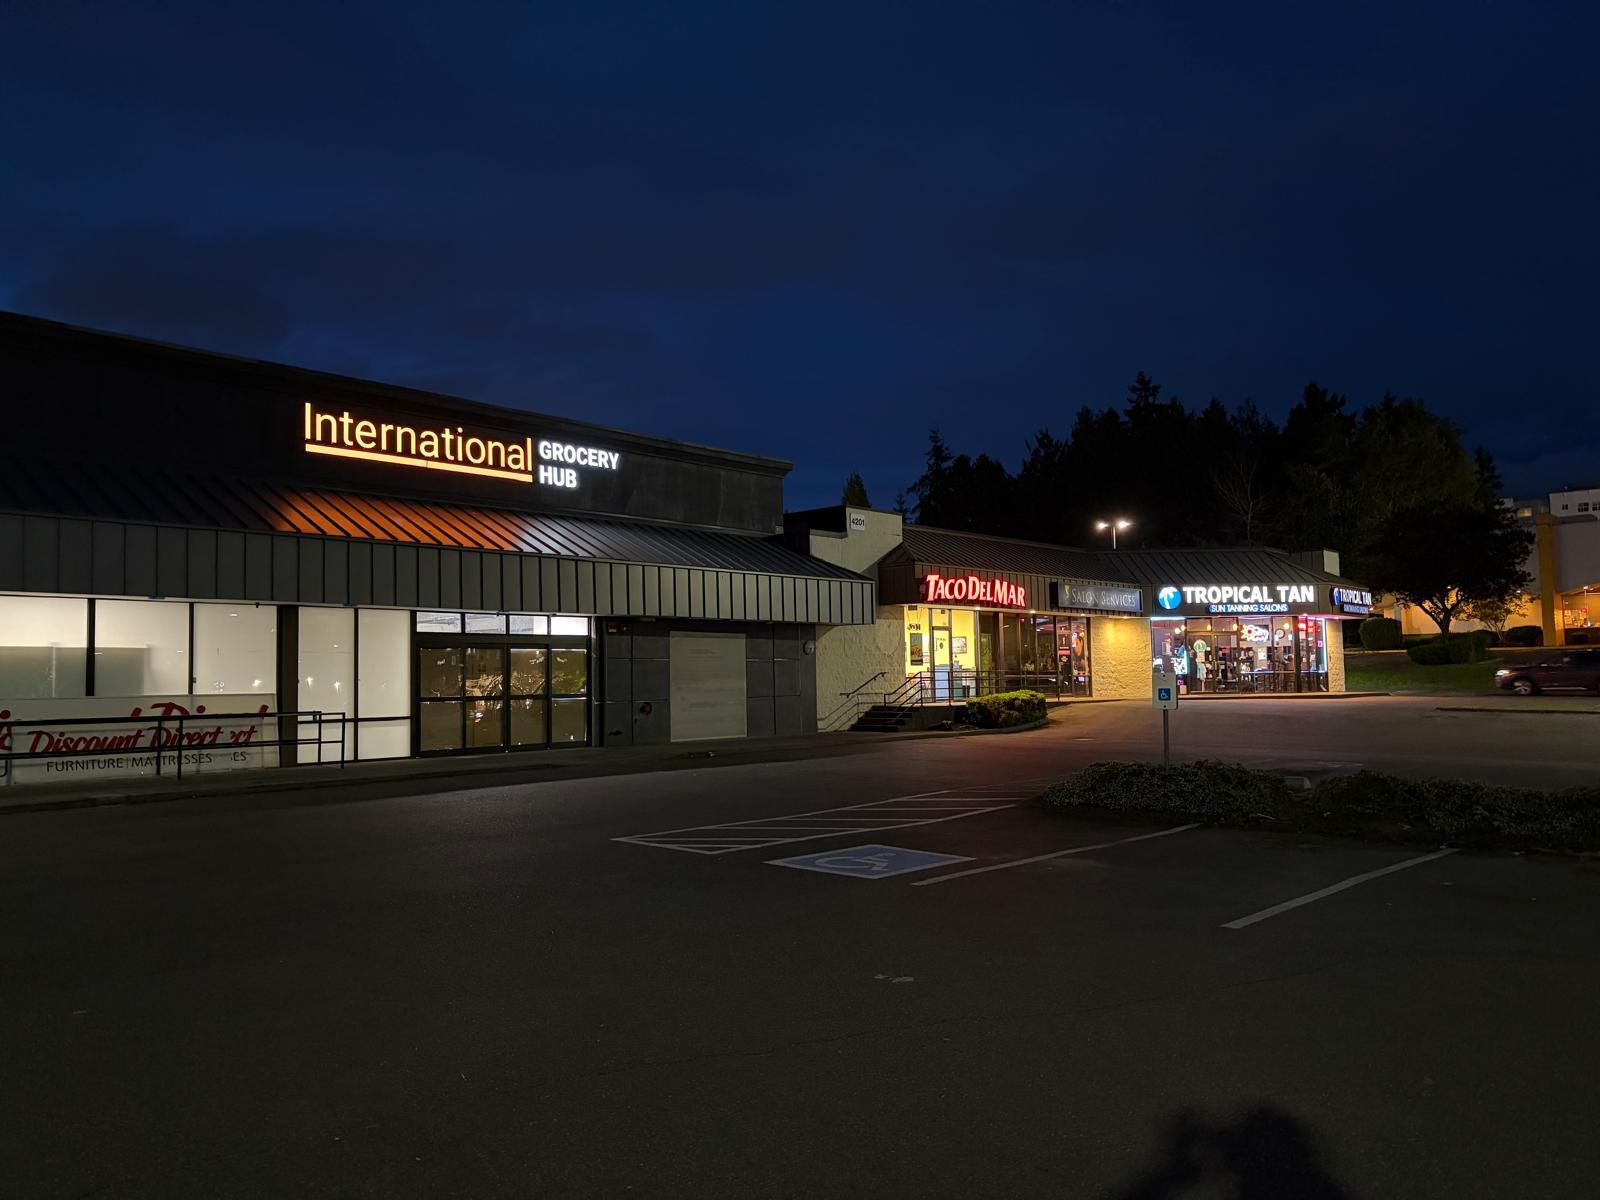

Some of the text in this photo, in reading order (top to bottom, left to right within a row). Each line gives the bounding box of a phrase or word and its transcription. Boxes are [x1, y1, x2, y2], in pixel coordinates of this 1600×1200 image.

[305, 402, 533, 471] International
[539, 440, 620, 471] GROCERY
[539, 465, 578, 488] HUB
[1182, 585, 1315, 604] TROPICAL TAN
[1210, 603, 1288, 613] SUN TANNING SALONS
[27, 729, 145, 753] Discount
[46, 757, 124, 773] FURNITURE
[131, 752, 213, 768] MATRSSES
